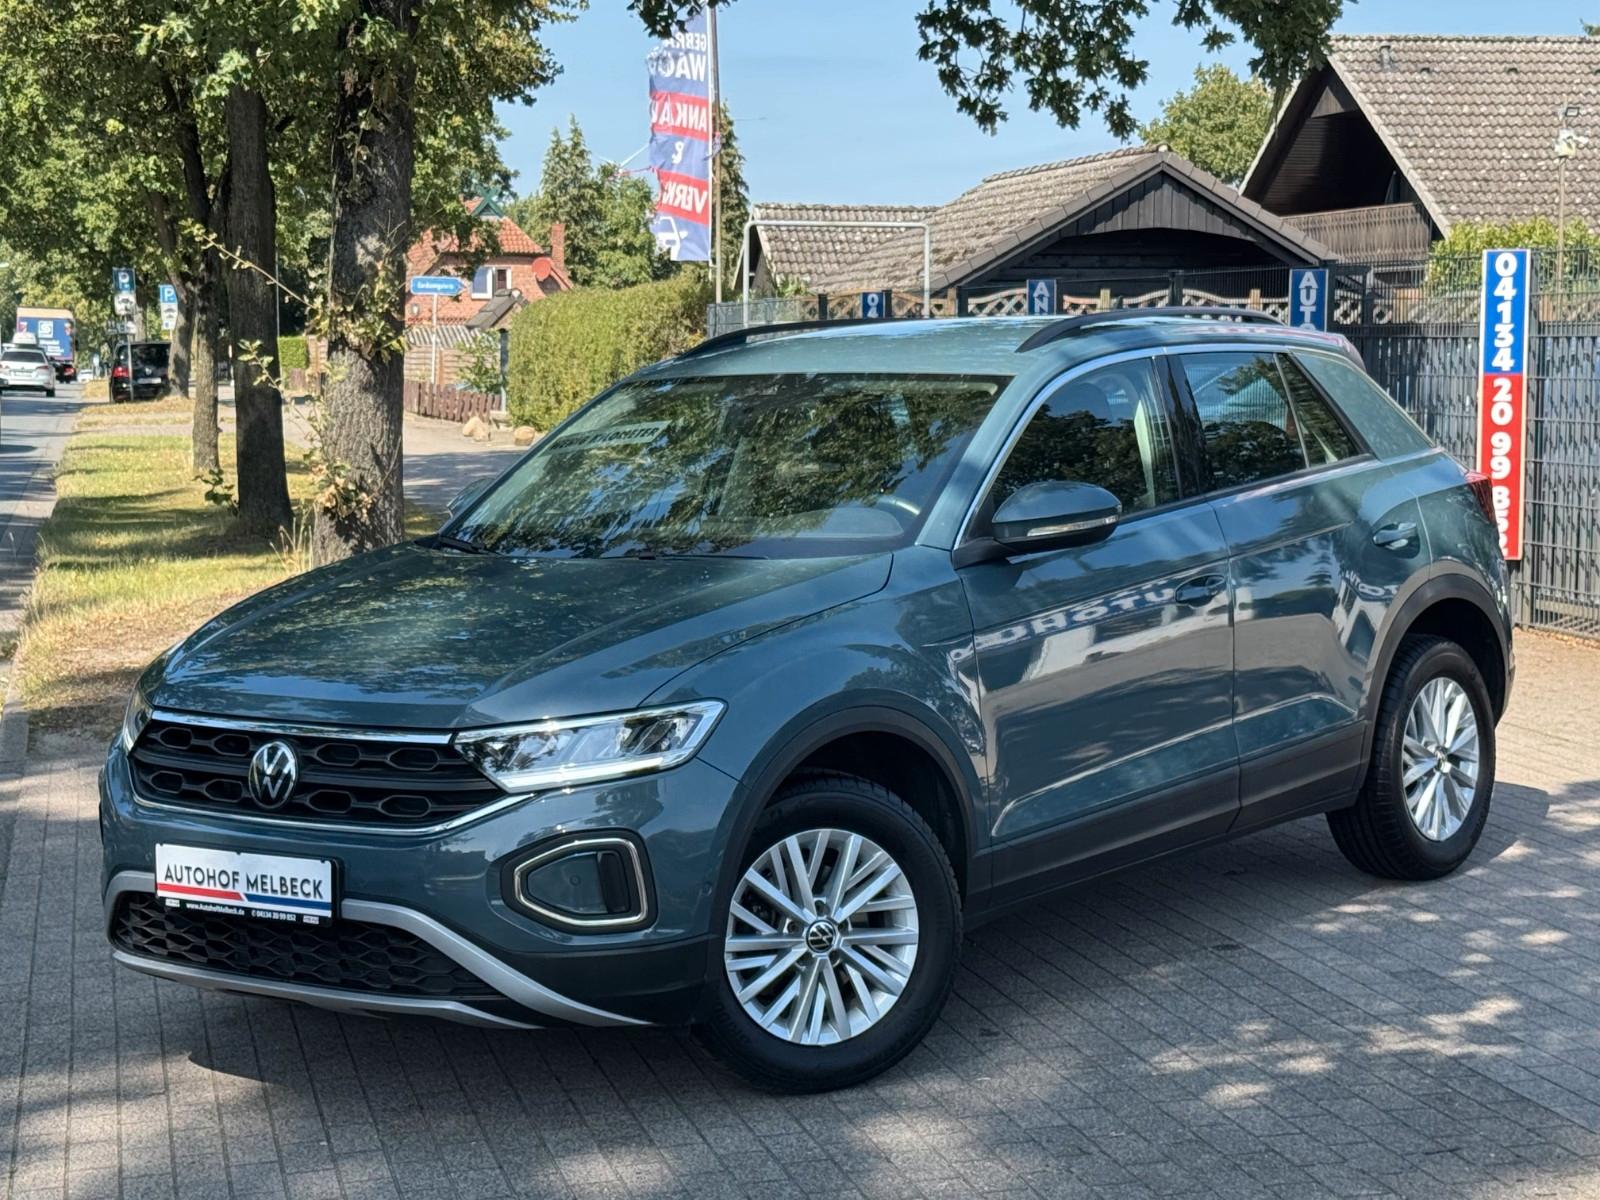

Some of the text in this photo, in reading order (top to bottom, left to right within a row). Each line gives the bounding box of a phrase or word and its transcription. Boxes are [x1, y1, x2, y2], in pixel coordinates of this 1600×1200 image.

[118, 272, 129, 289] P
[164, 288, 174, 301] P
[1492, 252, 1518, 371] 04134
[1491, 378, 1513, 426] 20
[1490, 431, 1512, 480] 99
[164, 864, 323, 899] AUTOHOF MELBECK
